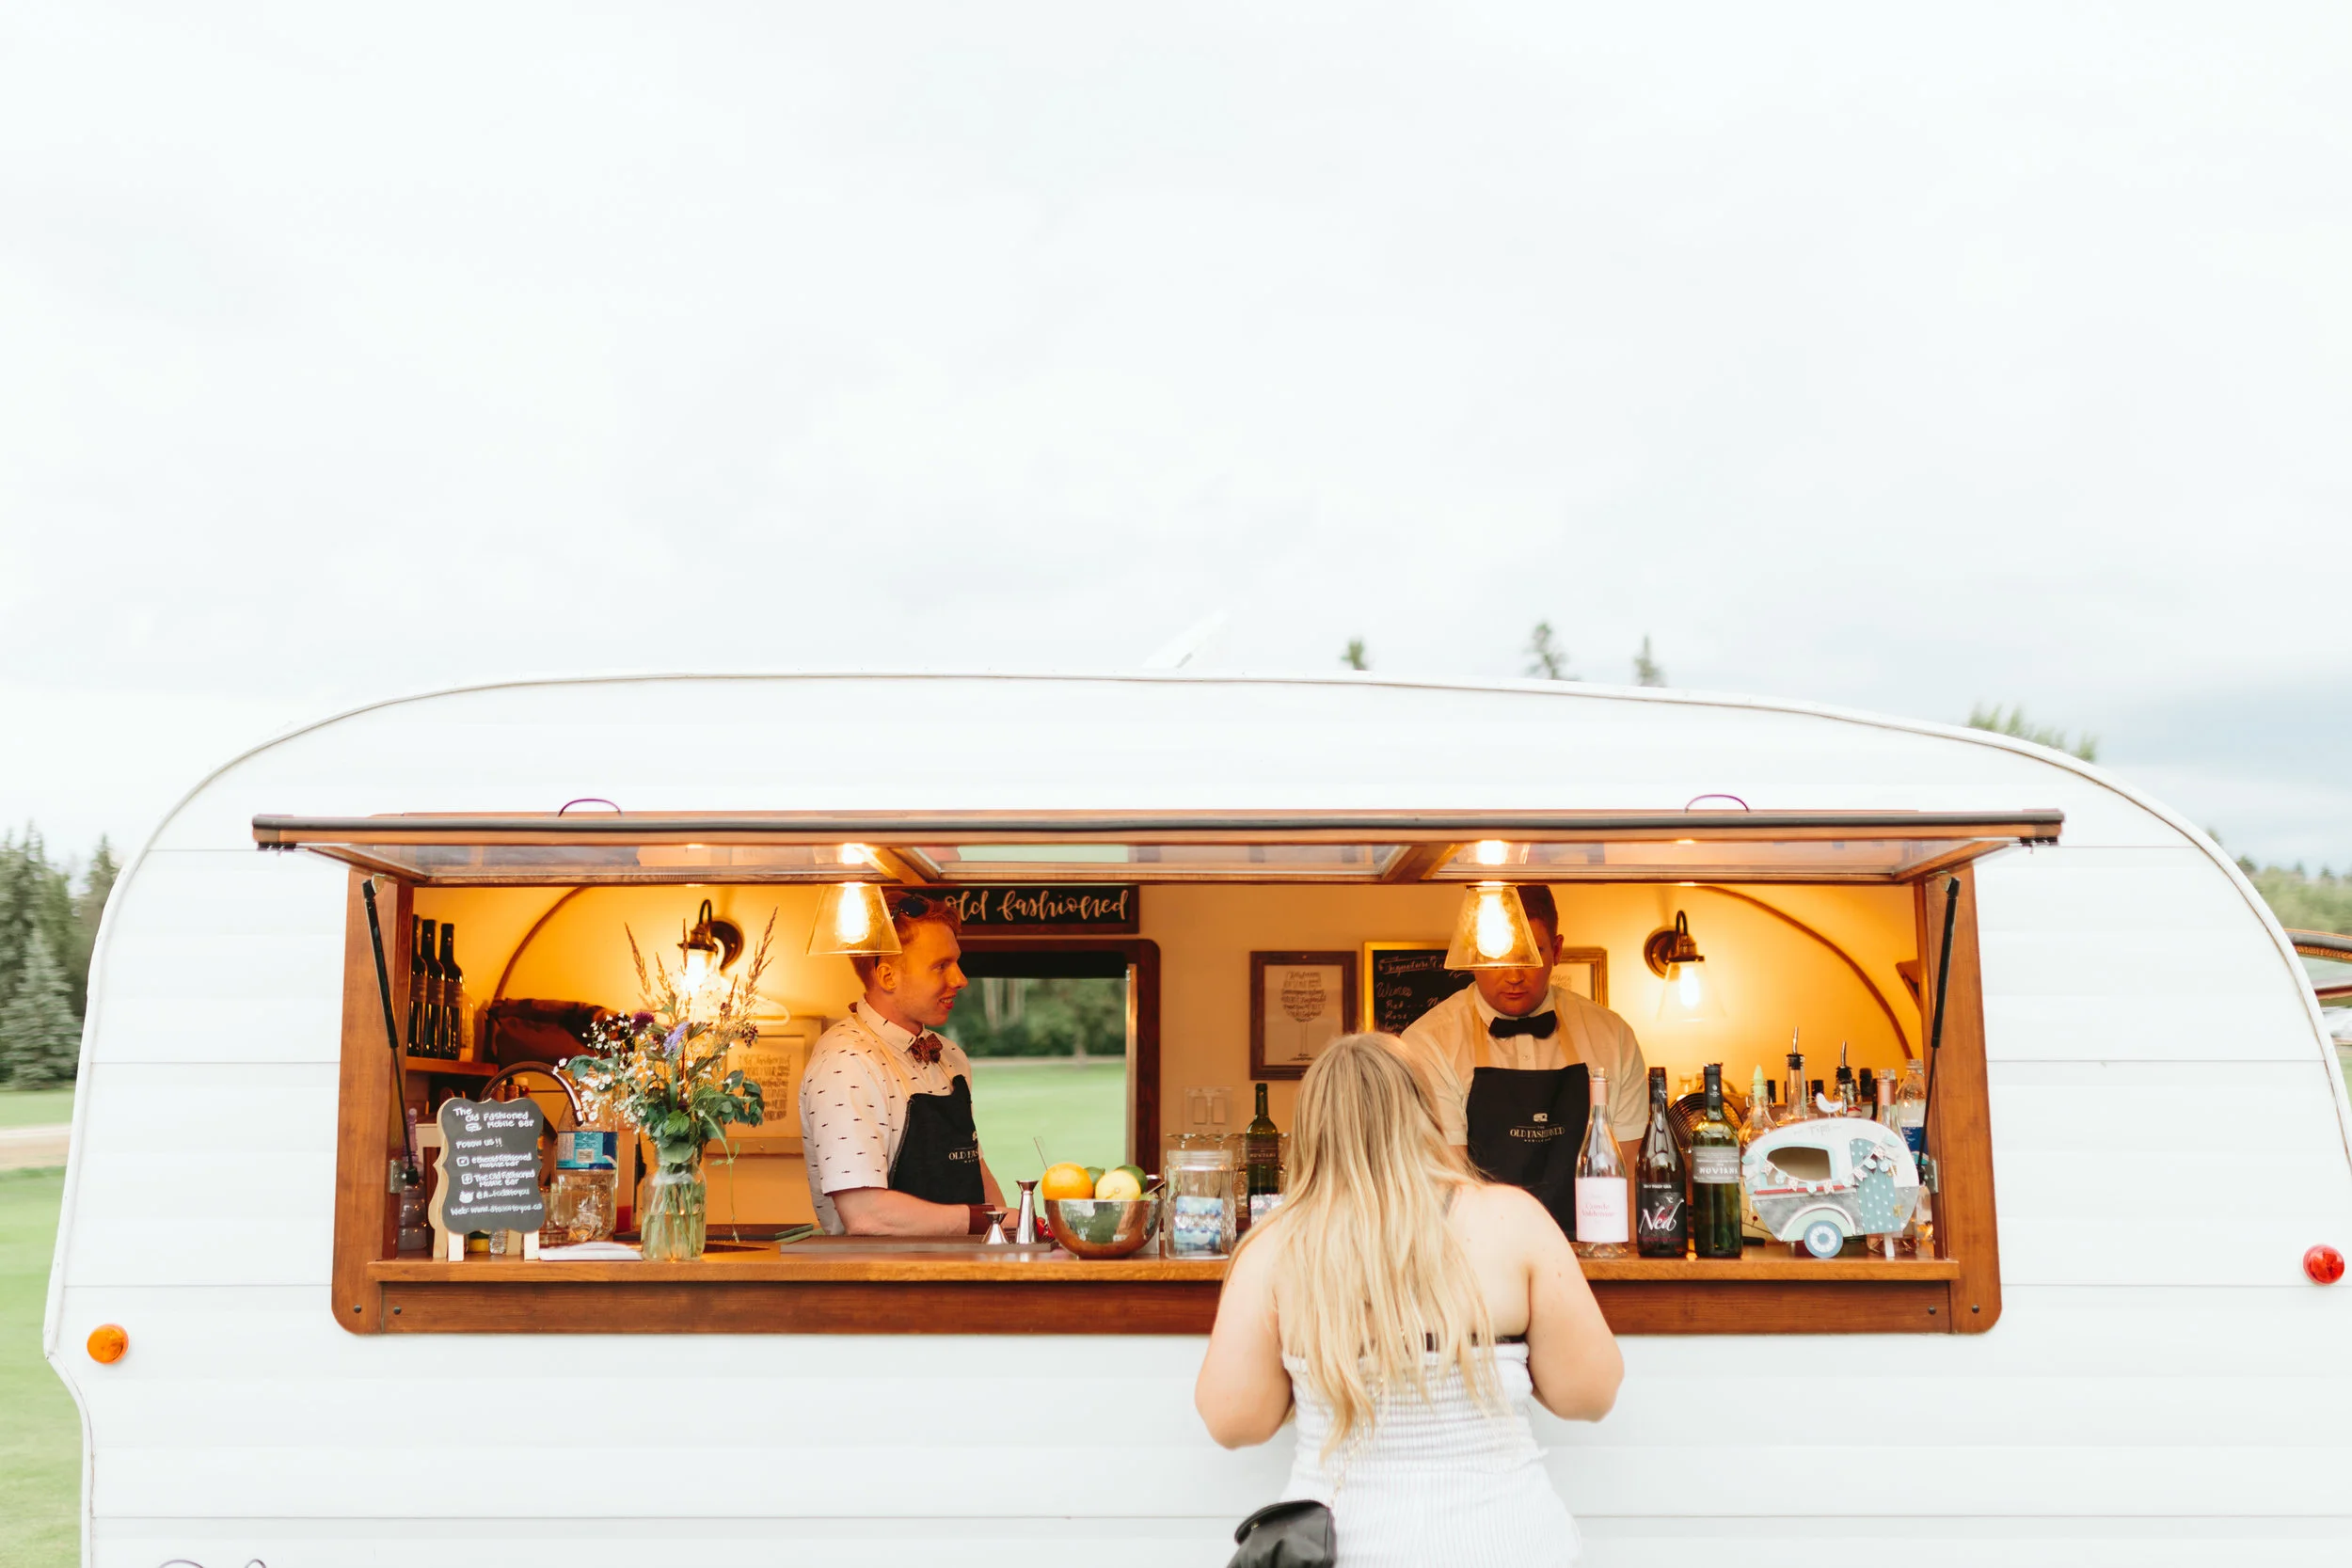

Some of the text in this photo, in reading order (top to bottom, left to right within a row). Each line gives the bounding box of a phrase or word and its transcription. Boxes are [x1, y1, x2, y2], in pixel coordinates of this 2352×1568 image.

[944, 890, 1129, 921] old fashioned
[453, 1106, 473, 1117] The
[465, 1111, 530, 1123] Old Fashioned
[1510, 1128, 1527, 1138] OLD
[948, 1150, 966, 1161] OLD
[1638, 1198, 1685, 1234] Ned
